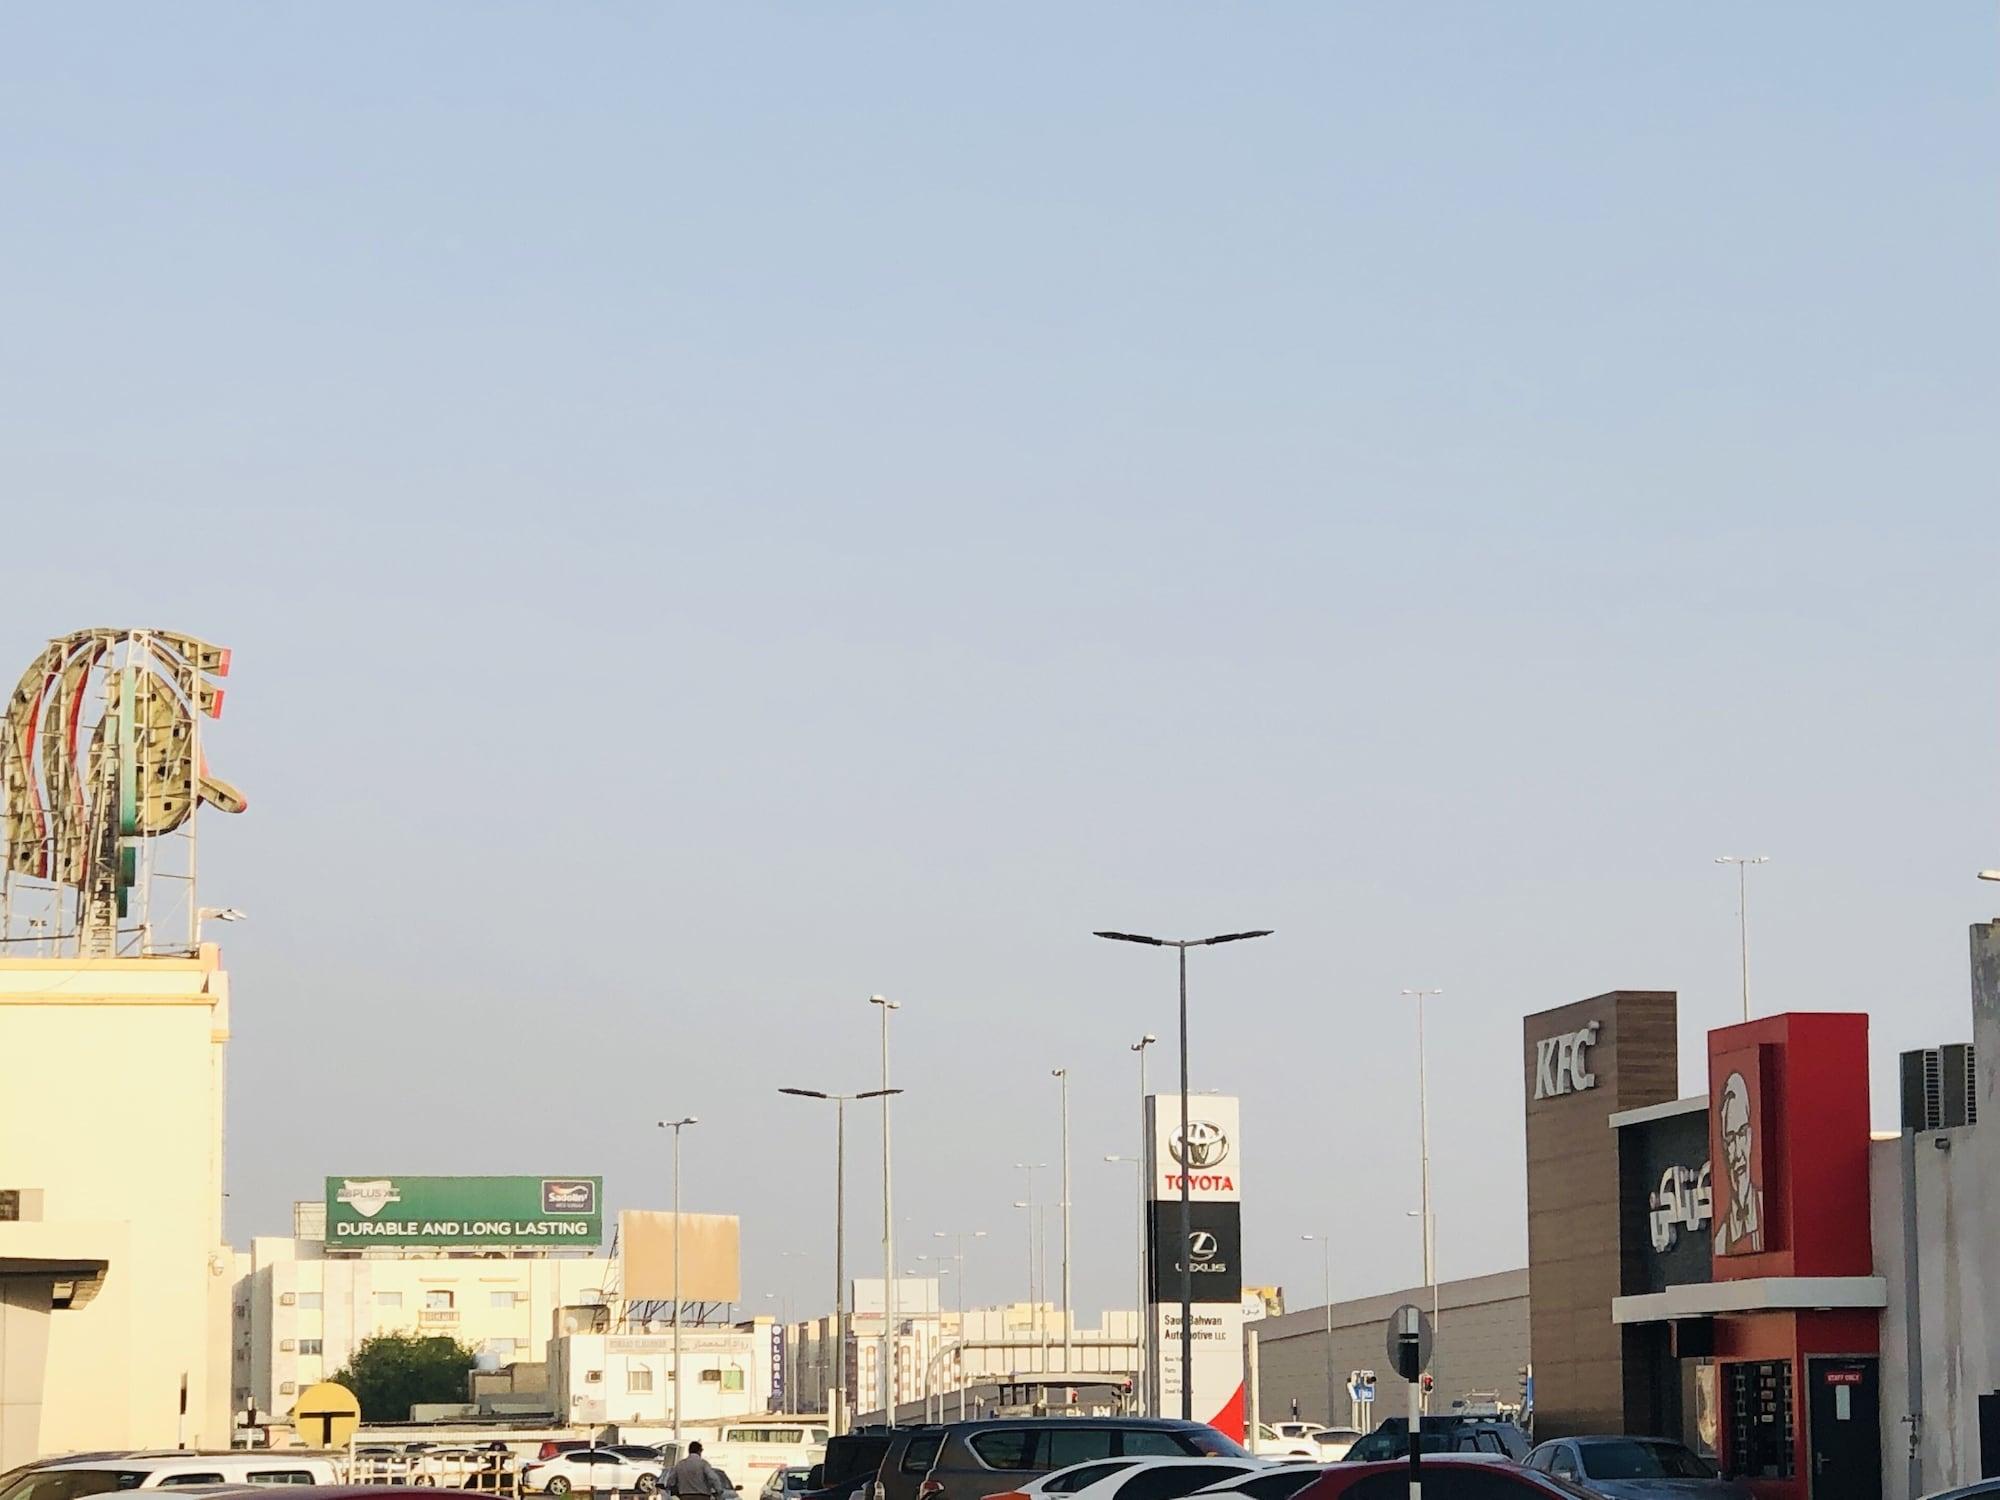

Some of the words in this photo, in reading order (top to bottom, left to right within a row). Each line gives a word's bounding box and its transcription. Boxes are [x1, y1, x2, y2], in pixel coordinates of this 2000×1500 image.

[1534, 1027, 1597, 1100] KFC
[337, 1221, 418, 1236] DURABLE
[421, 1221, 460, 1236] AND
[463, 1221, 512, 1236] LONG
[515, 1221, 588, 1236] LASTING
